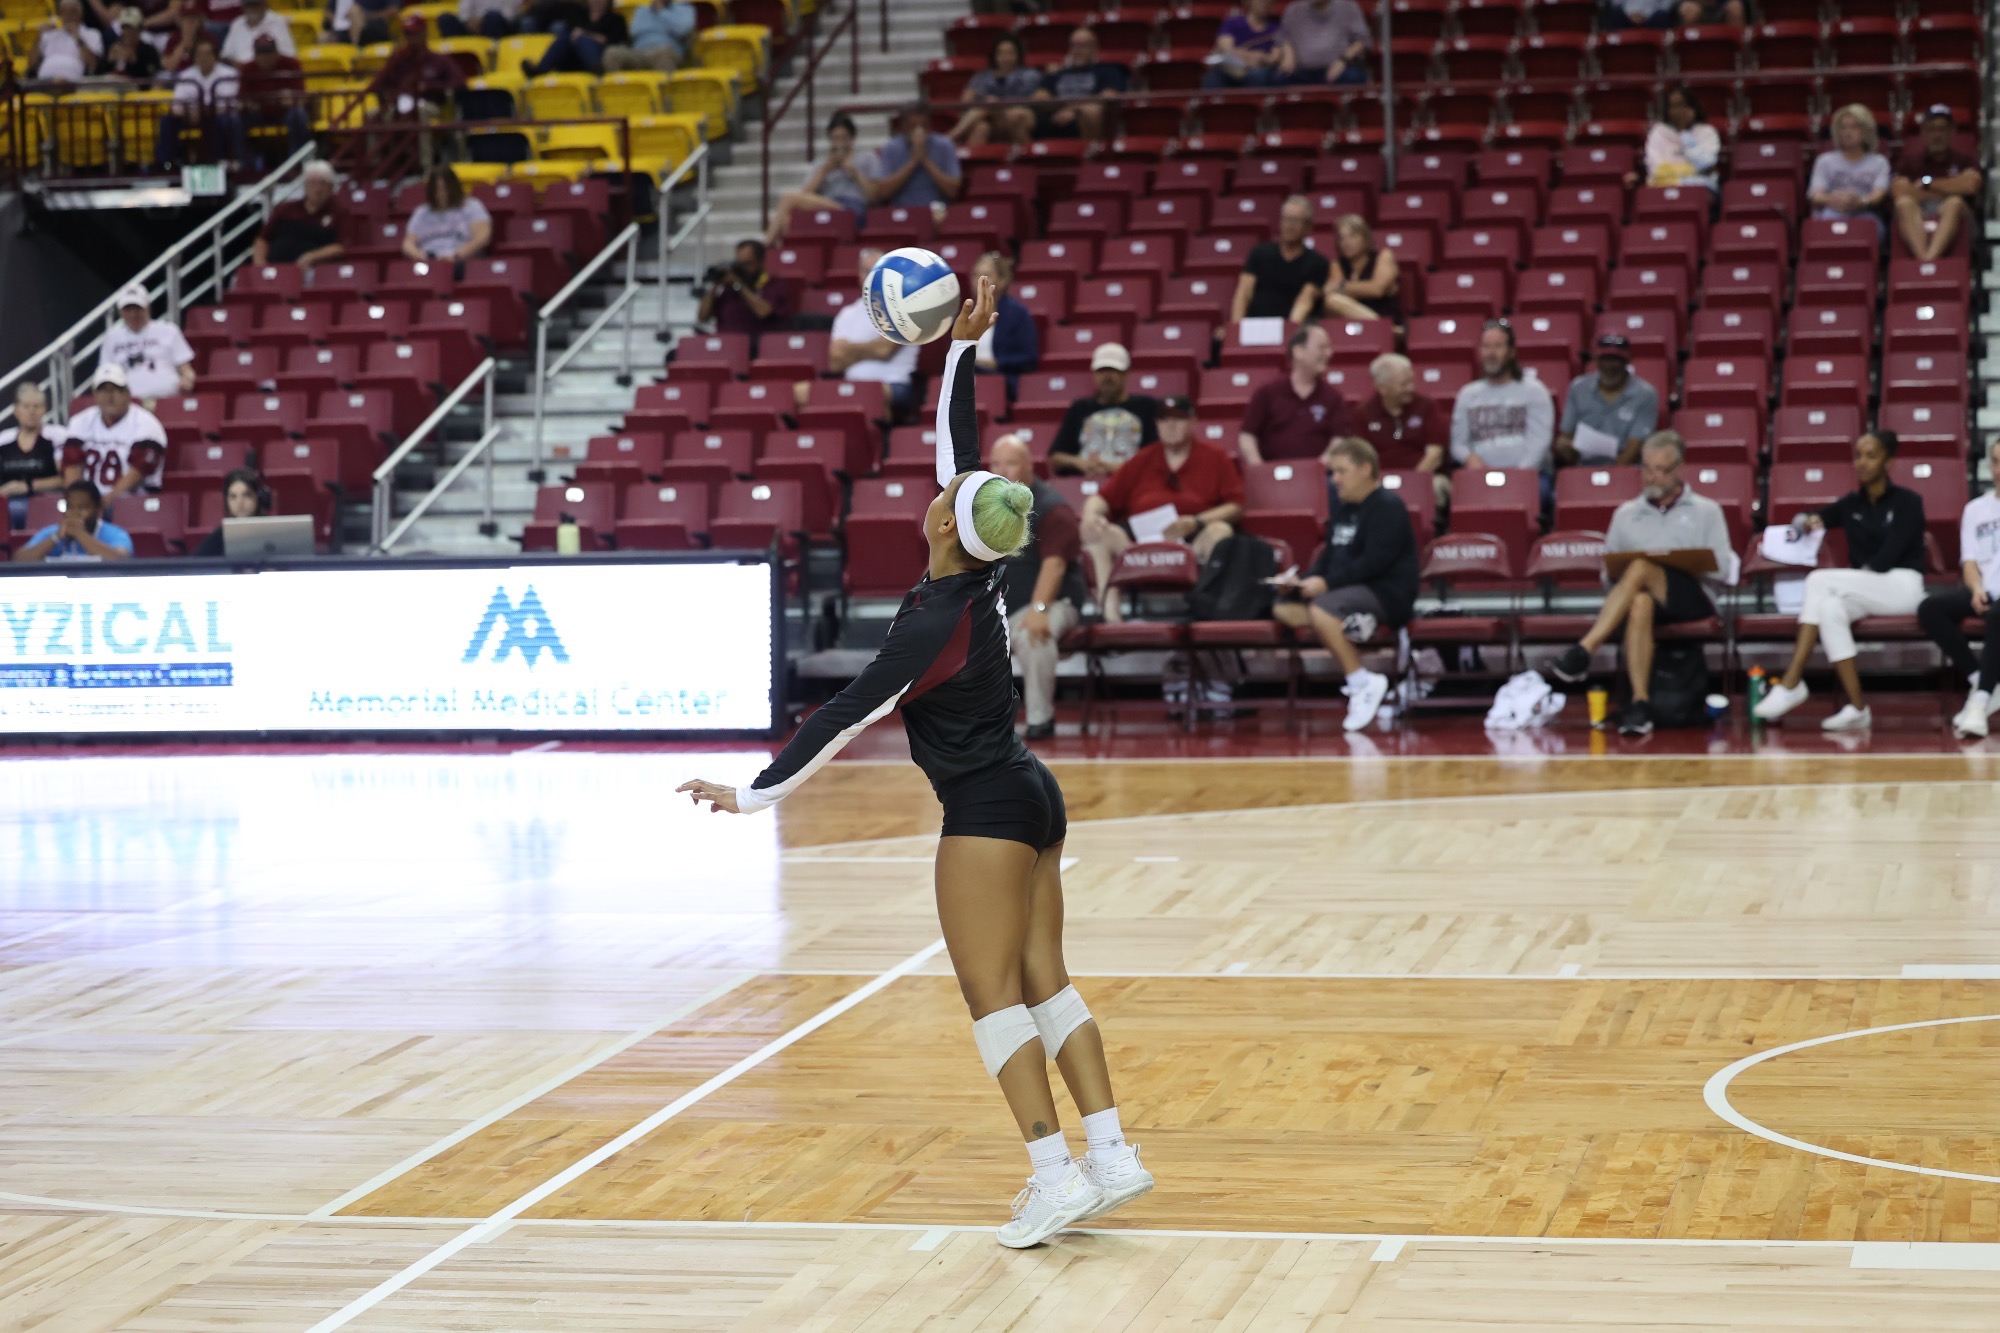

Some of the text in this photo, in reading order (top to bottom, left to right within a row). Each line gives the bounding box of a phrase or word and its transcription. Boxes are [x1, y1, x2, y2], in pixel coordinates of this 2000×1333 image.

[1, 601, 234, 656] YZICAL
[307, 682, 727, 716] Memorial Medical Center
